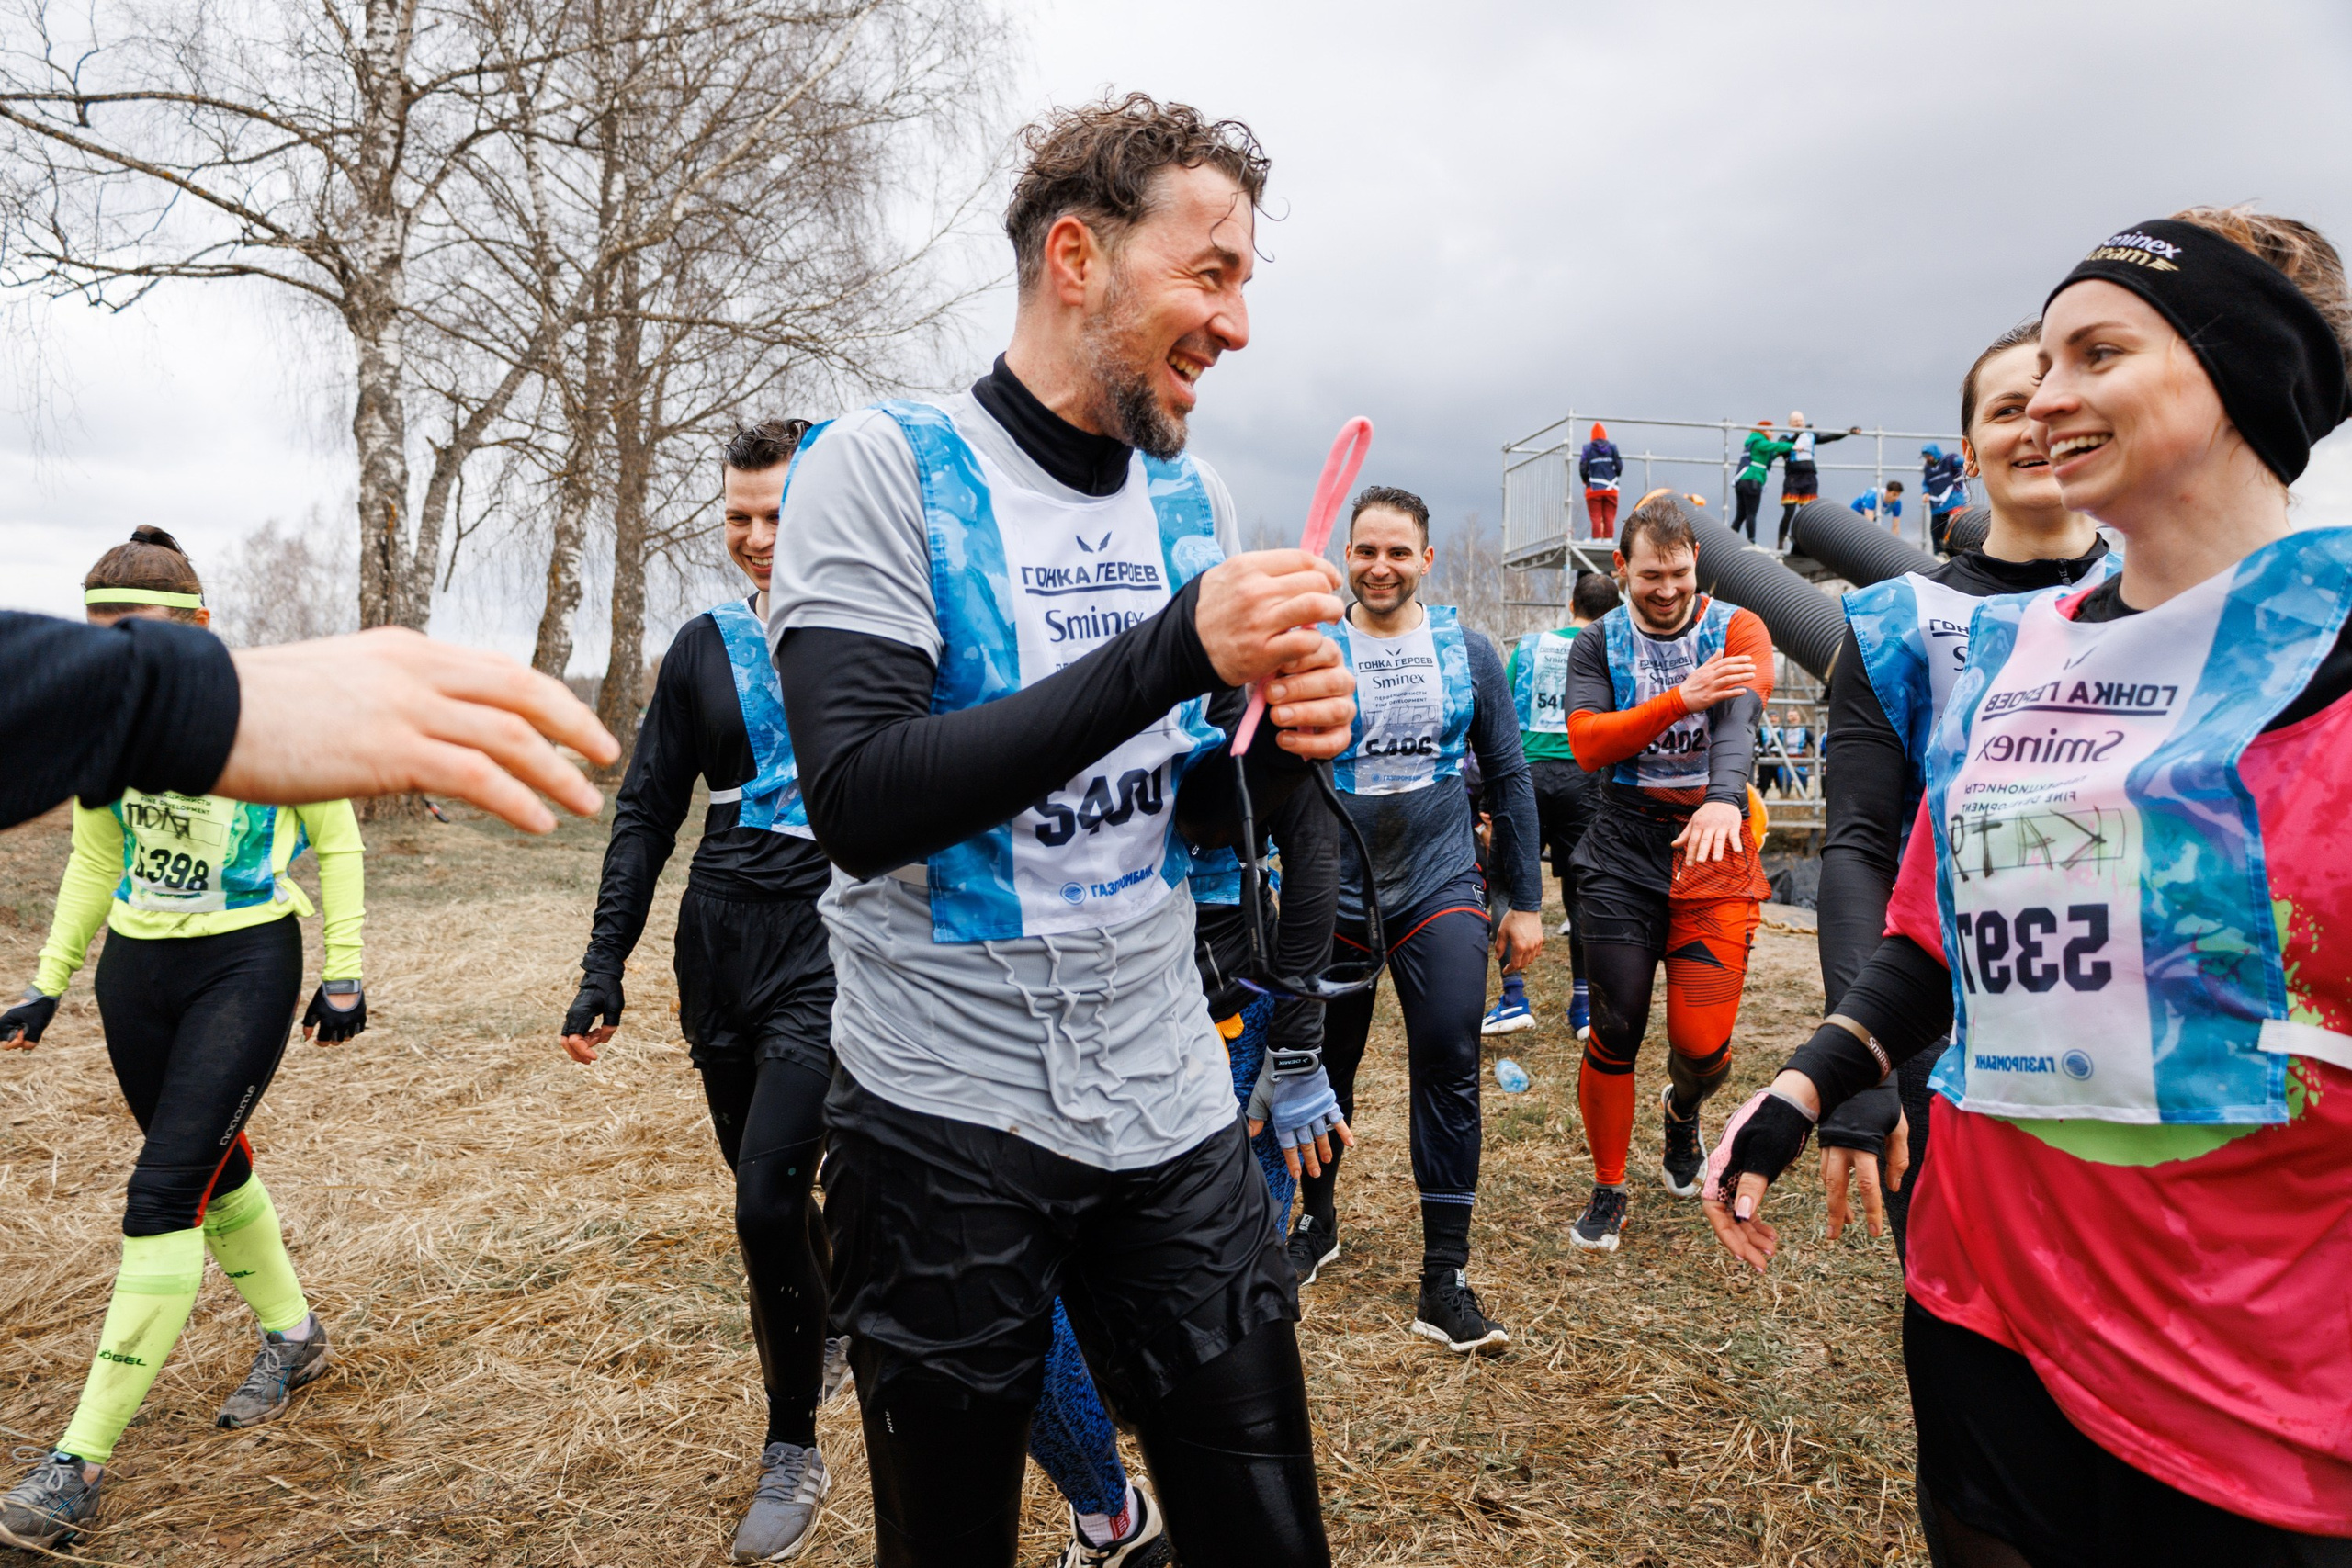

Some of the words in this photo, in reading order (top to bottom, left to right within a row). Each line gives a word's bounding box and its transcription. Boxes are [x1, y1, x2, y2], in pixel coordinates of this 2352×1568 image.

[1021, 566, 1091, 588] ГОНКА
[1095, 562, 1159, 583] ГЕРОЕВ
[1929, 618, 1969, 632] ГОН
[1359, 660, 1392, 670] ГОНКА
[1396, 657, 1433, 668] ГЕРОЕВ
[1373, 673, 1426, 690] Sminex
[1091, 864, 1155, 898] ГАЗПРОМБАНК
